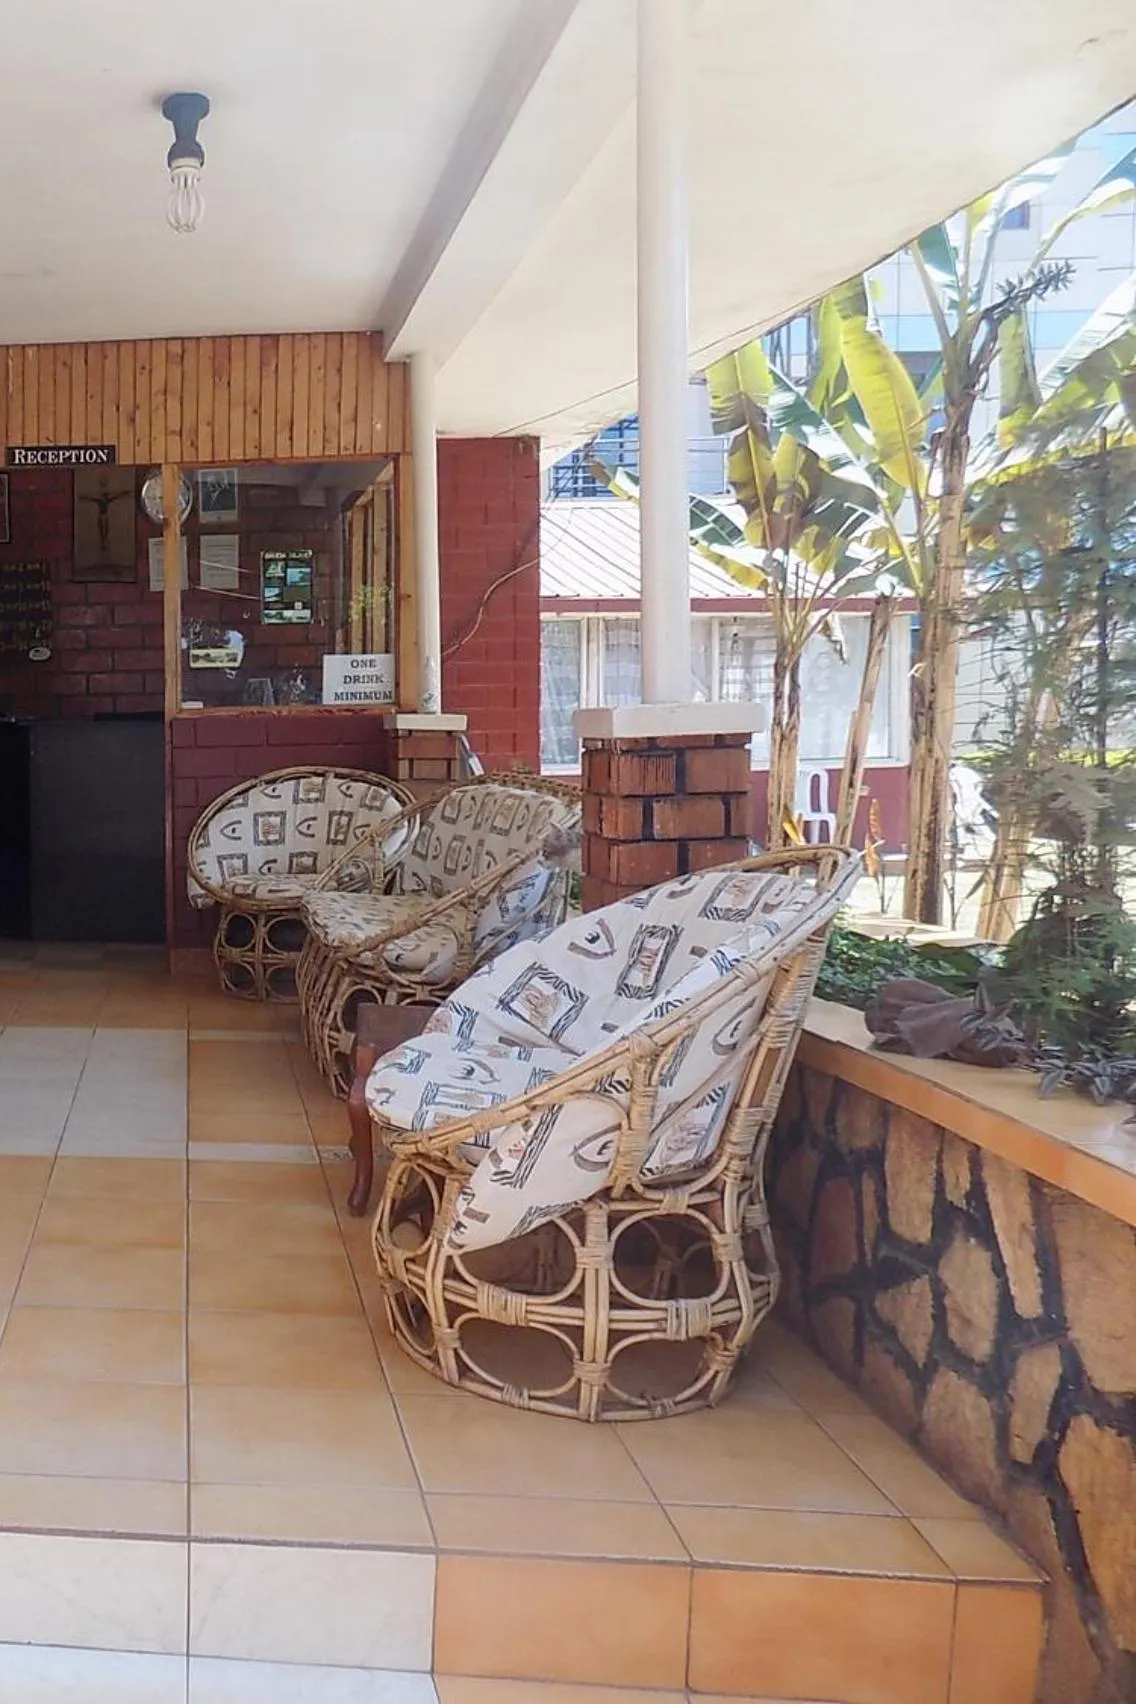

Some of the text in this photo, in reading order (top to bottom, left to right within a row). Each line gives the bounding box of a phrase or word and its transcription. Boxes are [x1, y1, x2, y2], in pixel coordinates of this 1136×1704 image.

[14, 449, 108, 464] RECEPTION
[350, 659, 377, 669] ONE
[343, 674, 385, 685] DRINK
[334, 690, 393, 701] MINIMUM
